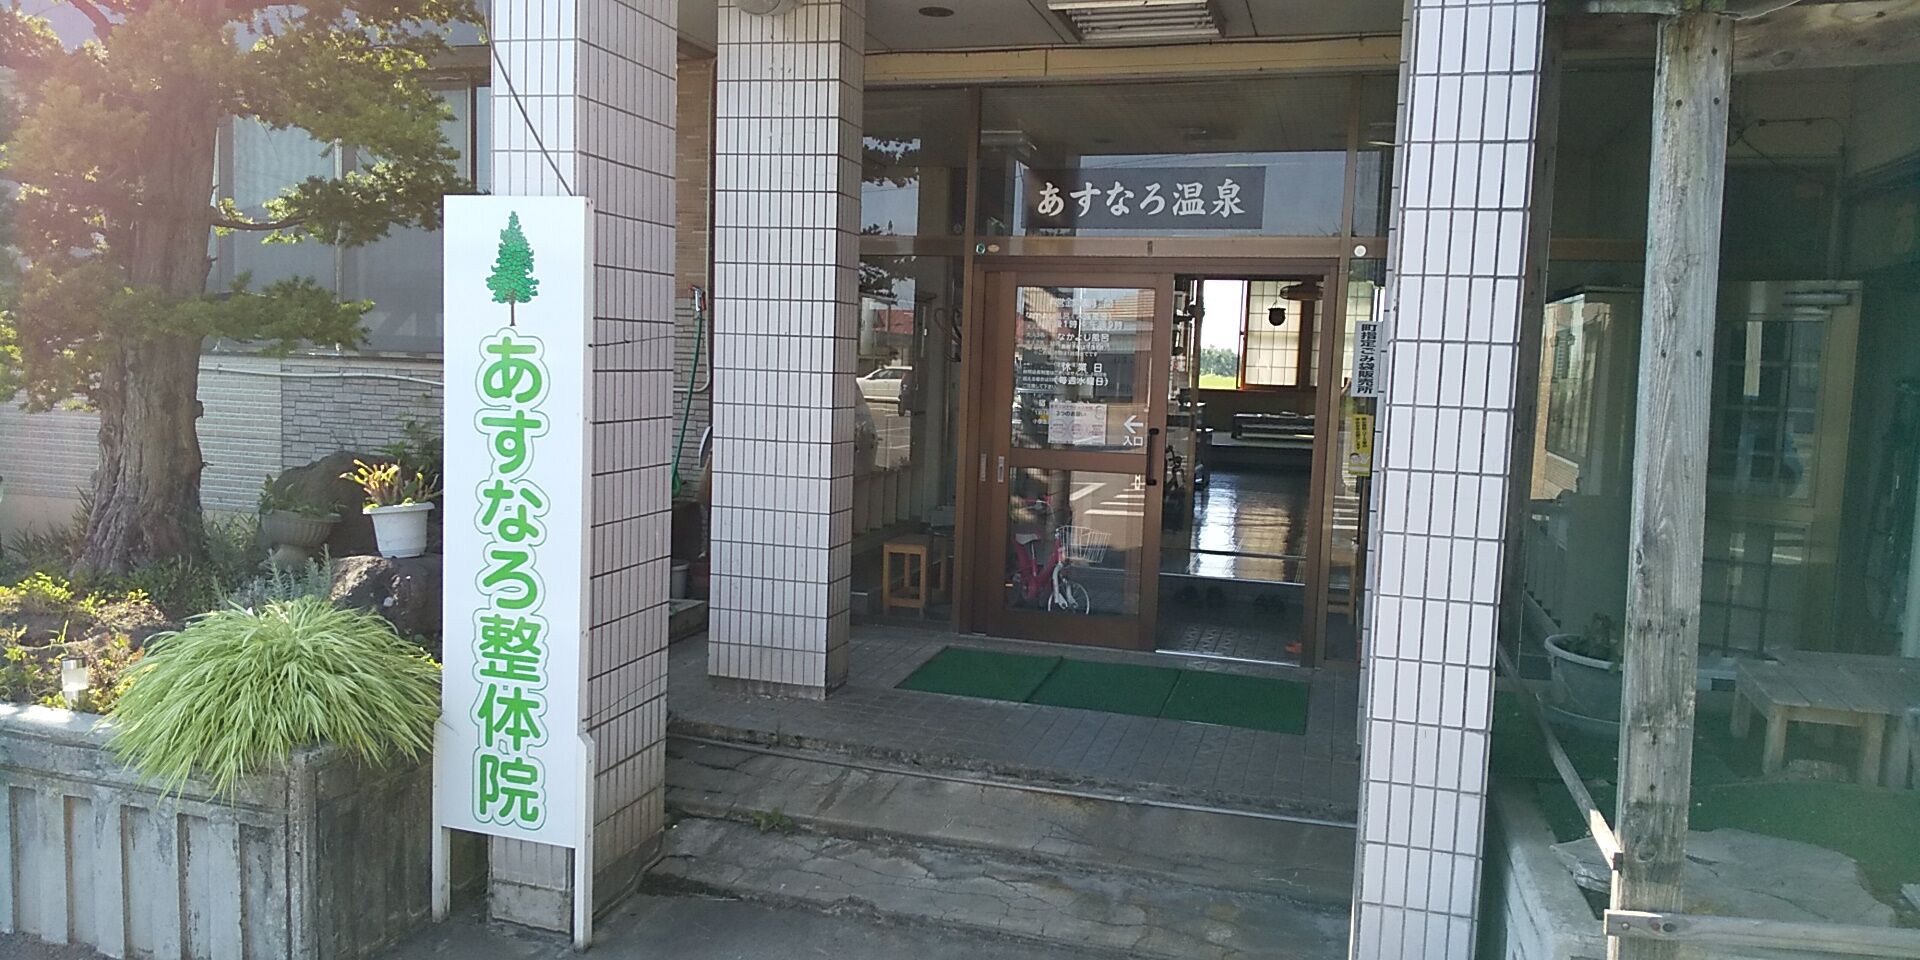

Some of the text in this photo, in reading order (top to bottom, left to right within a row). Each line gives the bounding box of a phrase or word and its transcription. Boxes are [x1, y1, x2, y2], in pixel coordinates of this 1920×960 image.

[1037, 178, 1245, 218] あすなろ温泉
[1057, 333, 1110, 342] なかよし風呂
[1357, 324, 1377, 394] 町指定ごみ袋販売所
[1123, 435, 1144, 446] 入口
[475, 334, 546, 826] あすなろ整体院
